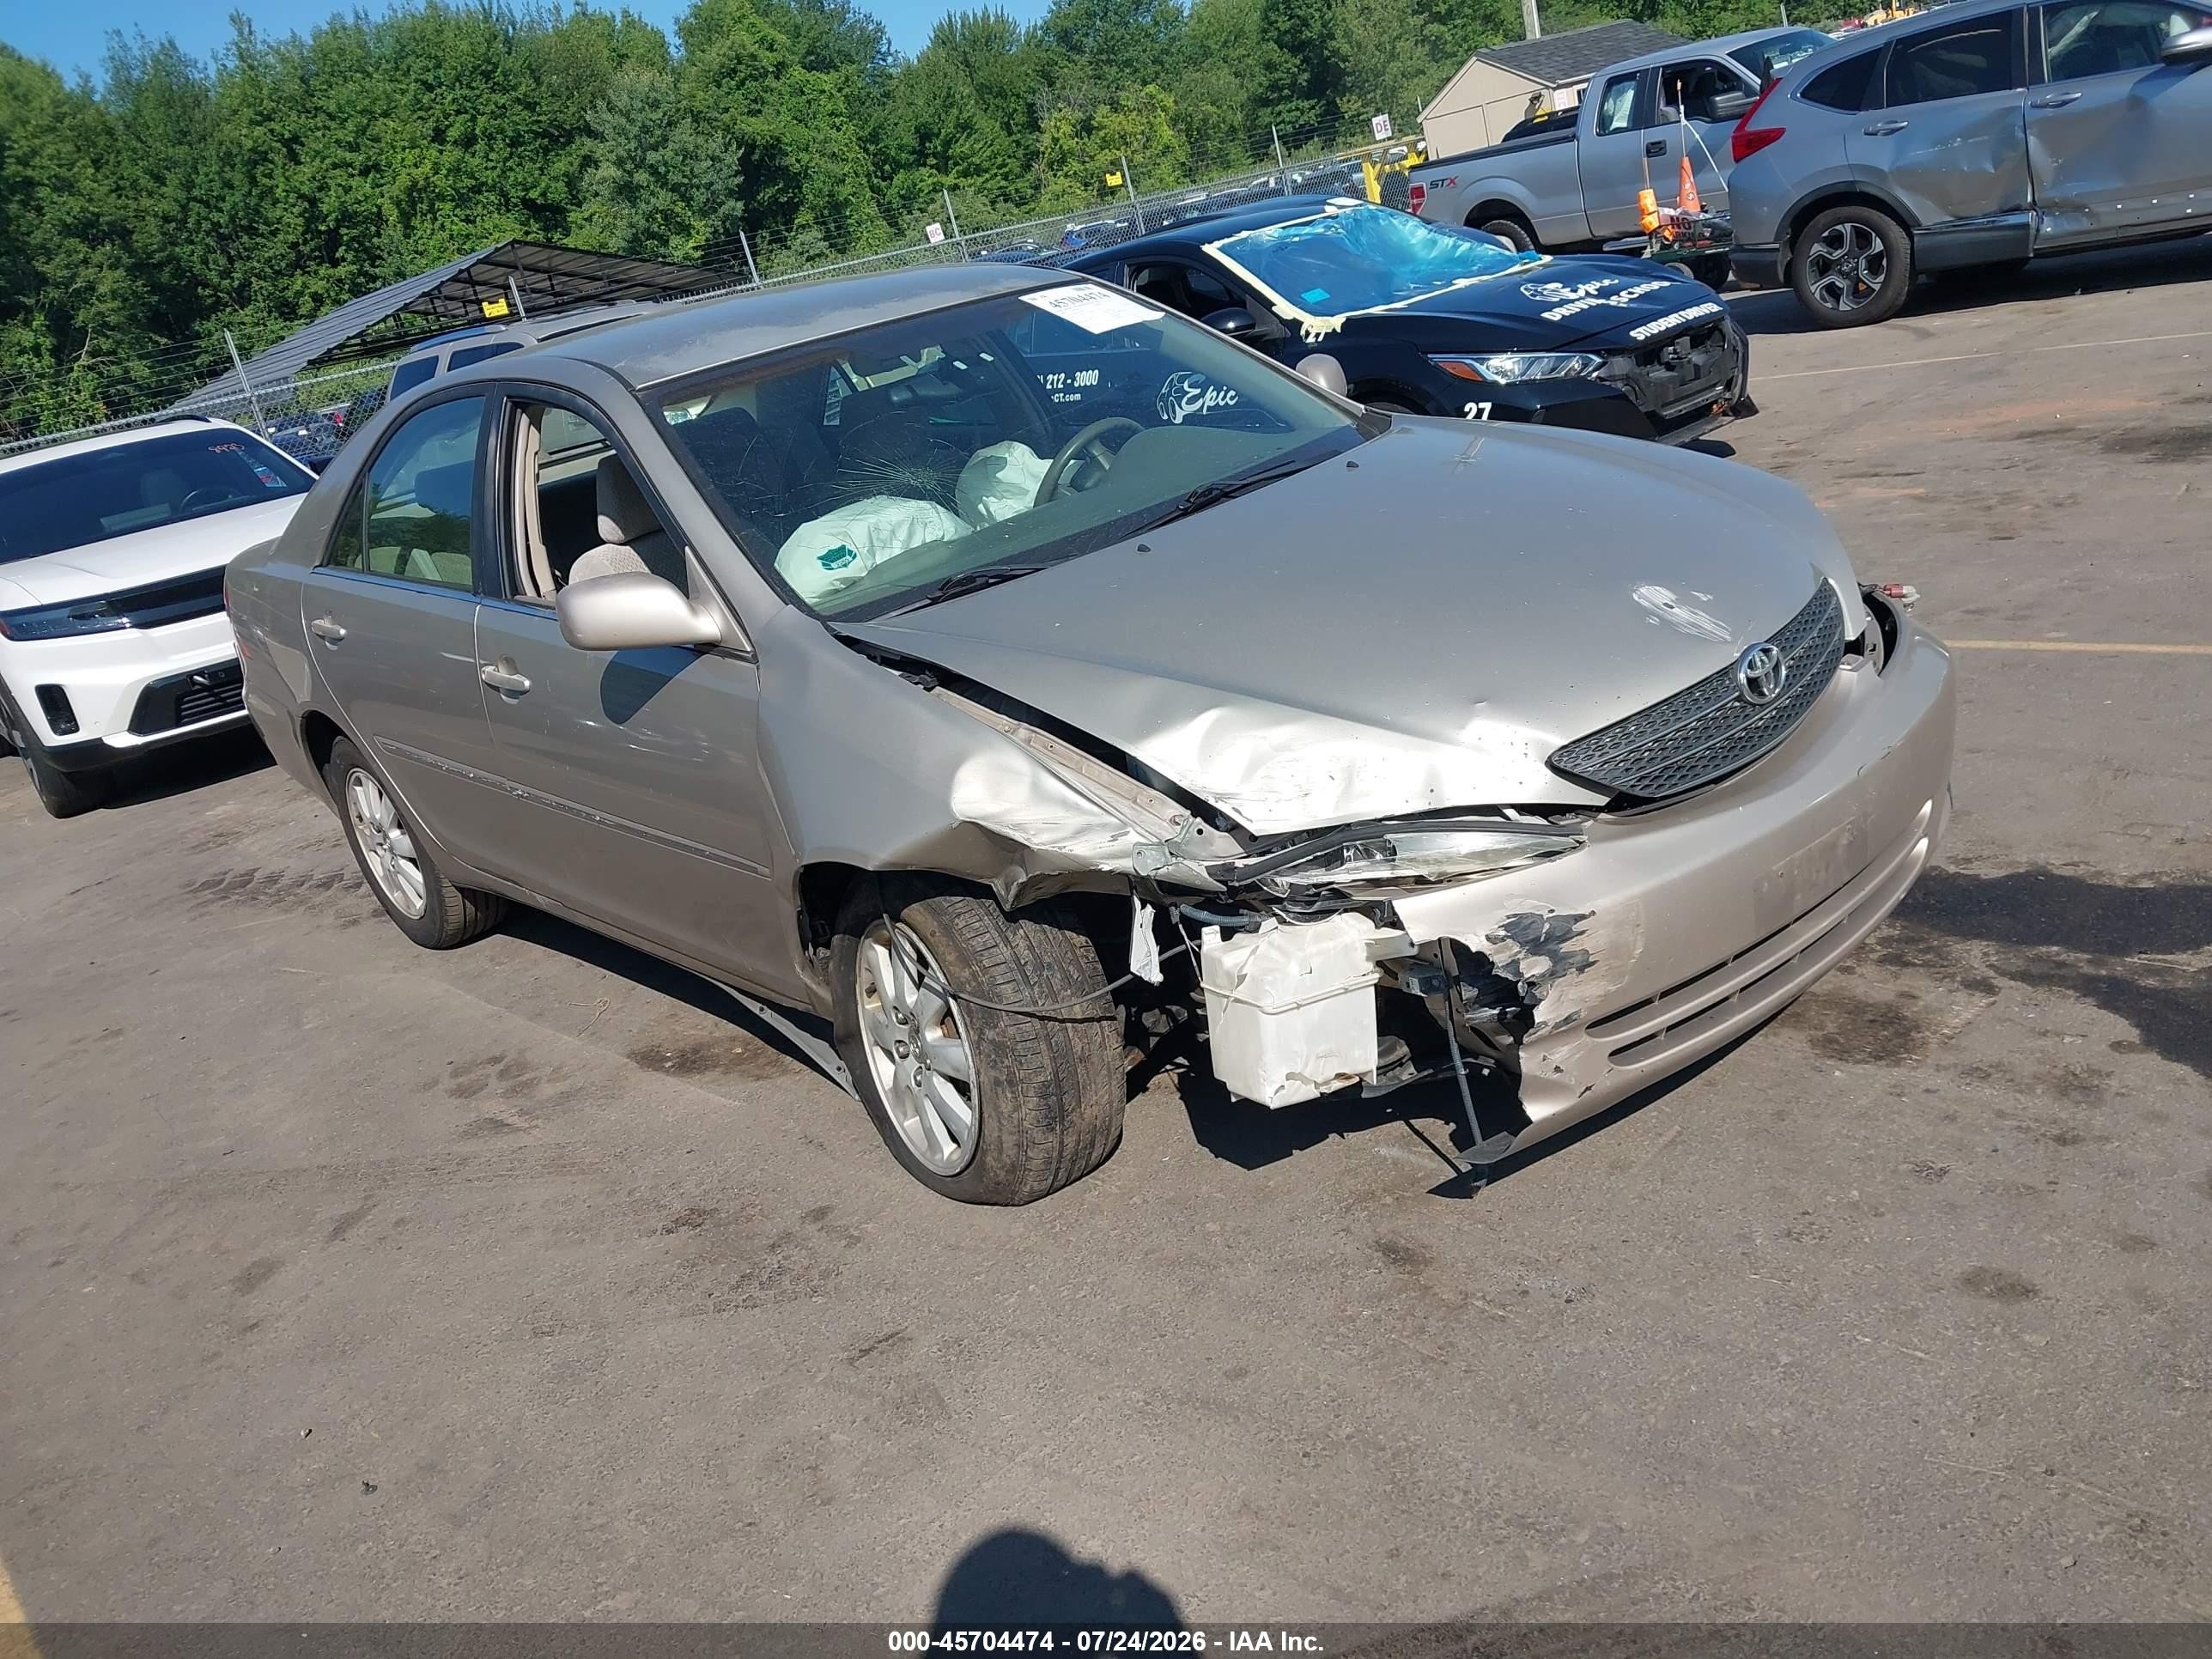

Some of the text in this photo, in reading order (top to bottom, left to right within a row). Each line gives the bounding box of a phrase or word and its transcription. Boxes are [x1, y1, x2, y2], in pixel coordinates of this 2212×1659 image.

[1375, 122, 1390, 134] DE
[1429, 175, 1459, 190] STX
[1669, 216, 1692, 230] NO
[1629, 302, 1723, 341] STUDENT DRIVER
[1046, 373, 1066, 390] 212
[1073, 369, 1099, 388] 3000
[1051, 392, 1082, 404] CT.com
[1181, 373, 1239, 416] Epic
[1463, 401, 1492, 421] 27
